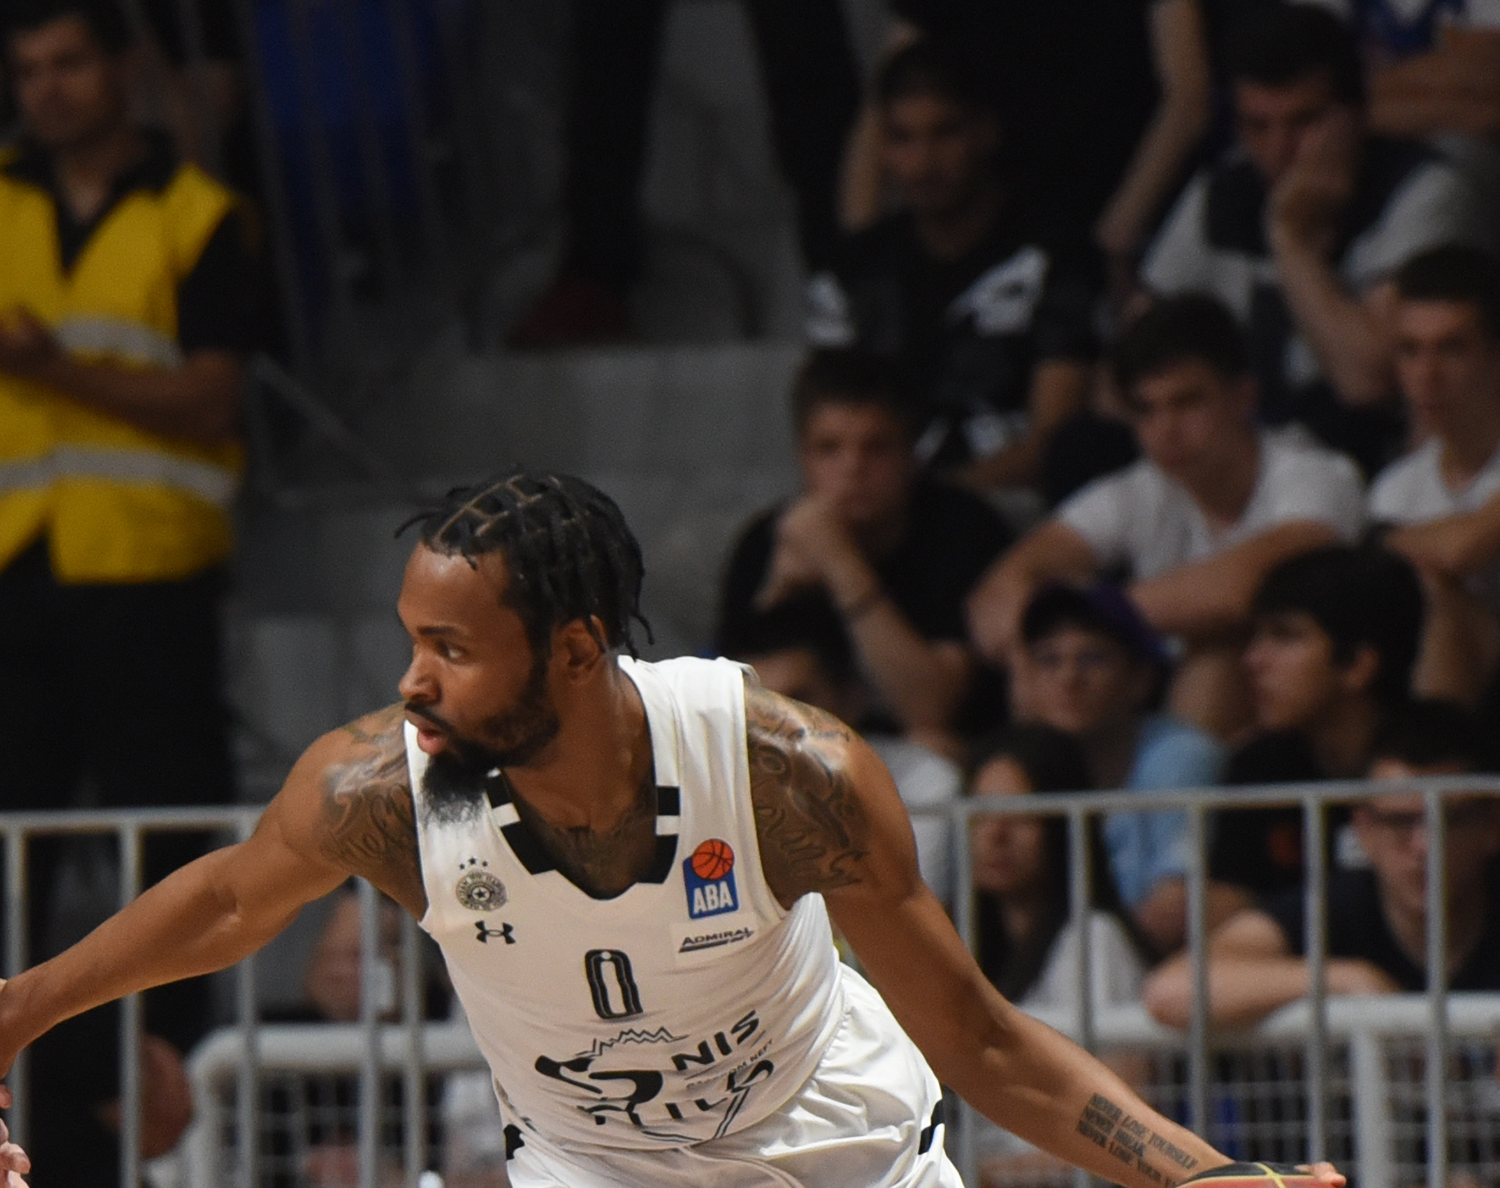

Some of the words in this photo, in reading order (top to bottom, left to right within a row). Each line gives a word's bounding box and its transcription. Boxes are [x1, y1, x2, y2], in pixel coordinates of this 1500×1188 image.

[693, 881, 734, 915] ABA
[682, 926, 750, 947] ADMIRAL
[584, 948, 644, 1020] 0
[671, 1010, 760, 1071] NIS
